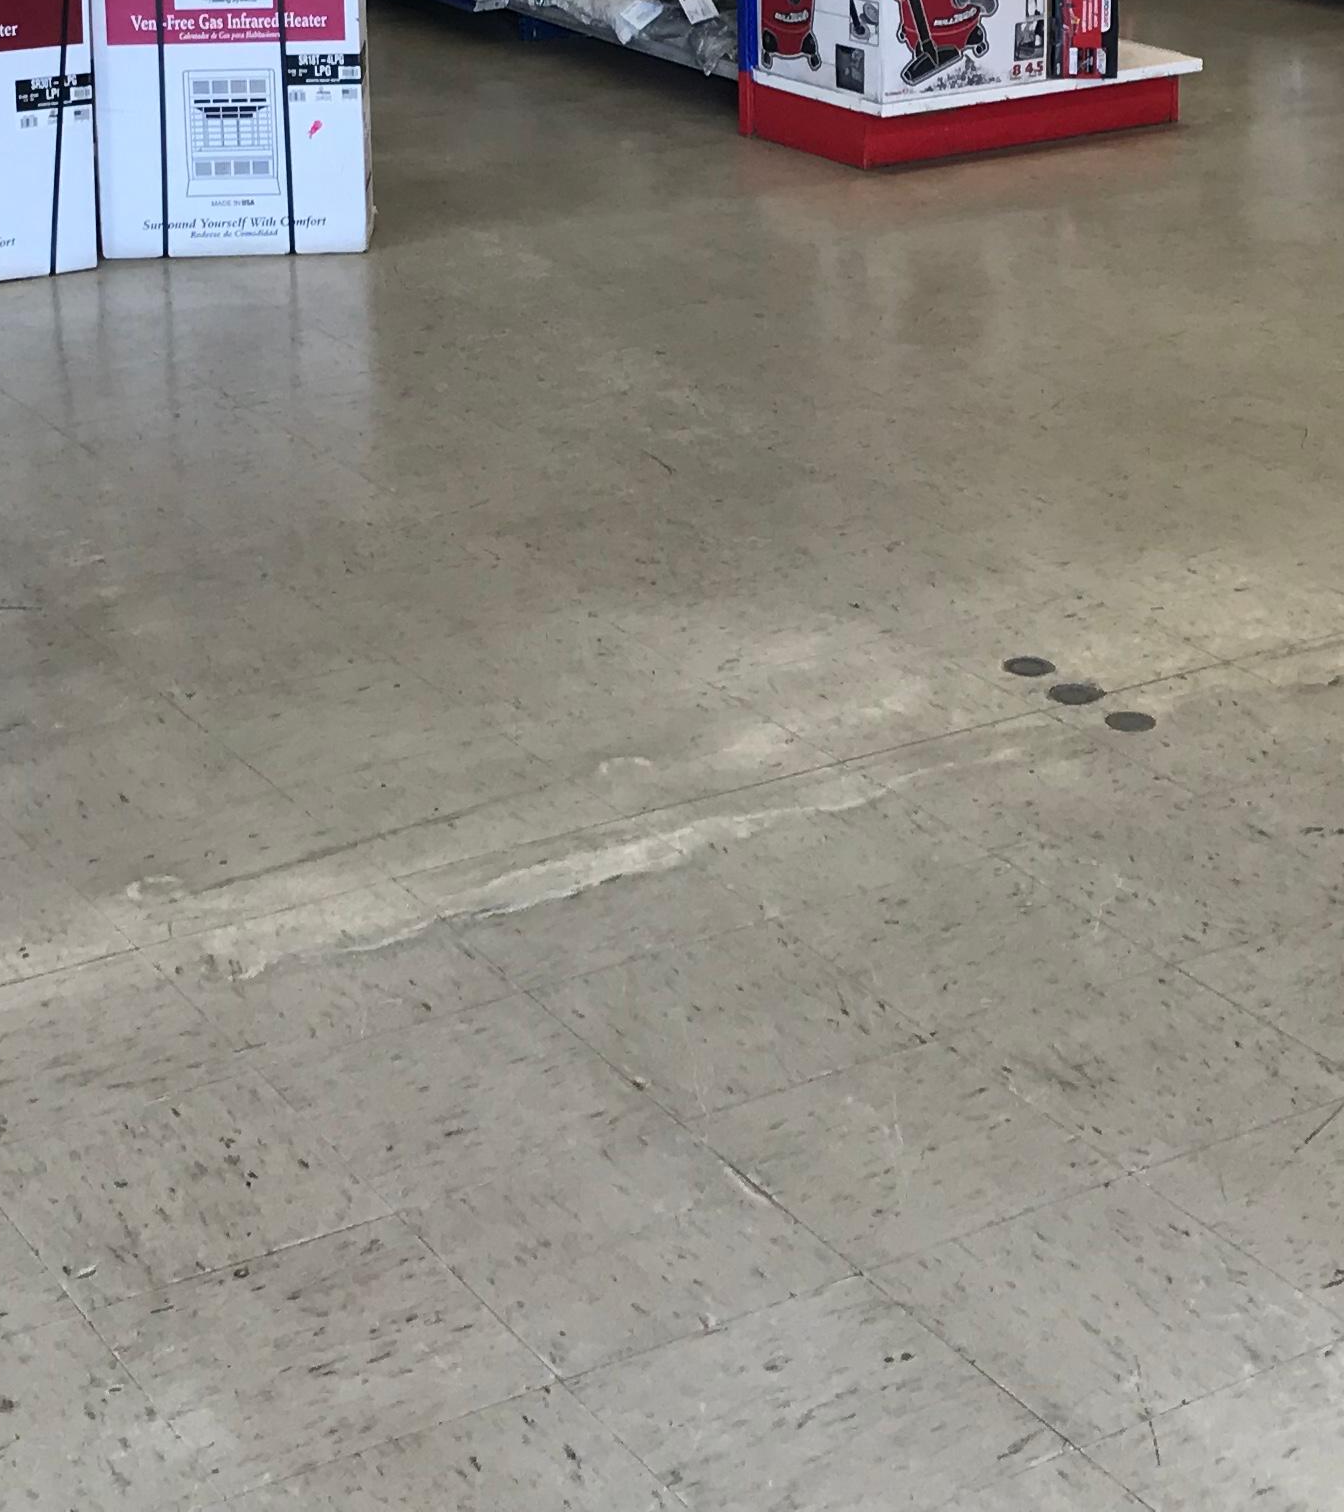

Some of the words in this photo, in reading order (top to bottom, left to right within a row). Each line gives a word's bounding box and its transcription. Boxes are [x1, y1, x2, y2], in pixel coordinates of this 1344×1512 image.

[130, 14, 195, 31] Ven-Free
[199, 14, 223, 30] Gas
[227, 13, 279, 29] Infrared
[284, 12, 327, 28] Heater
[314, 65, 331, 77] LPG
[1012, 64, 1020, 76] 8
[1025, 61, 1043, 74] 4.5
[143, 219, 196, 231] Suround
[201, 217, 248, 230] Yourself
[251, 217, 276, 227] With
